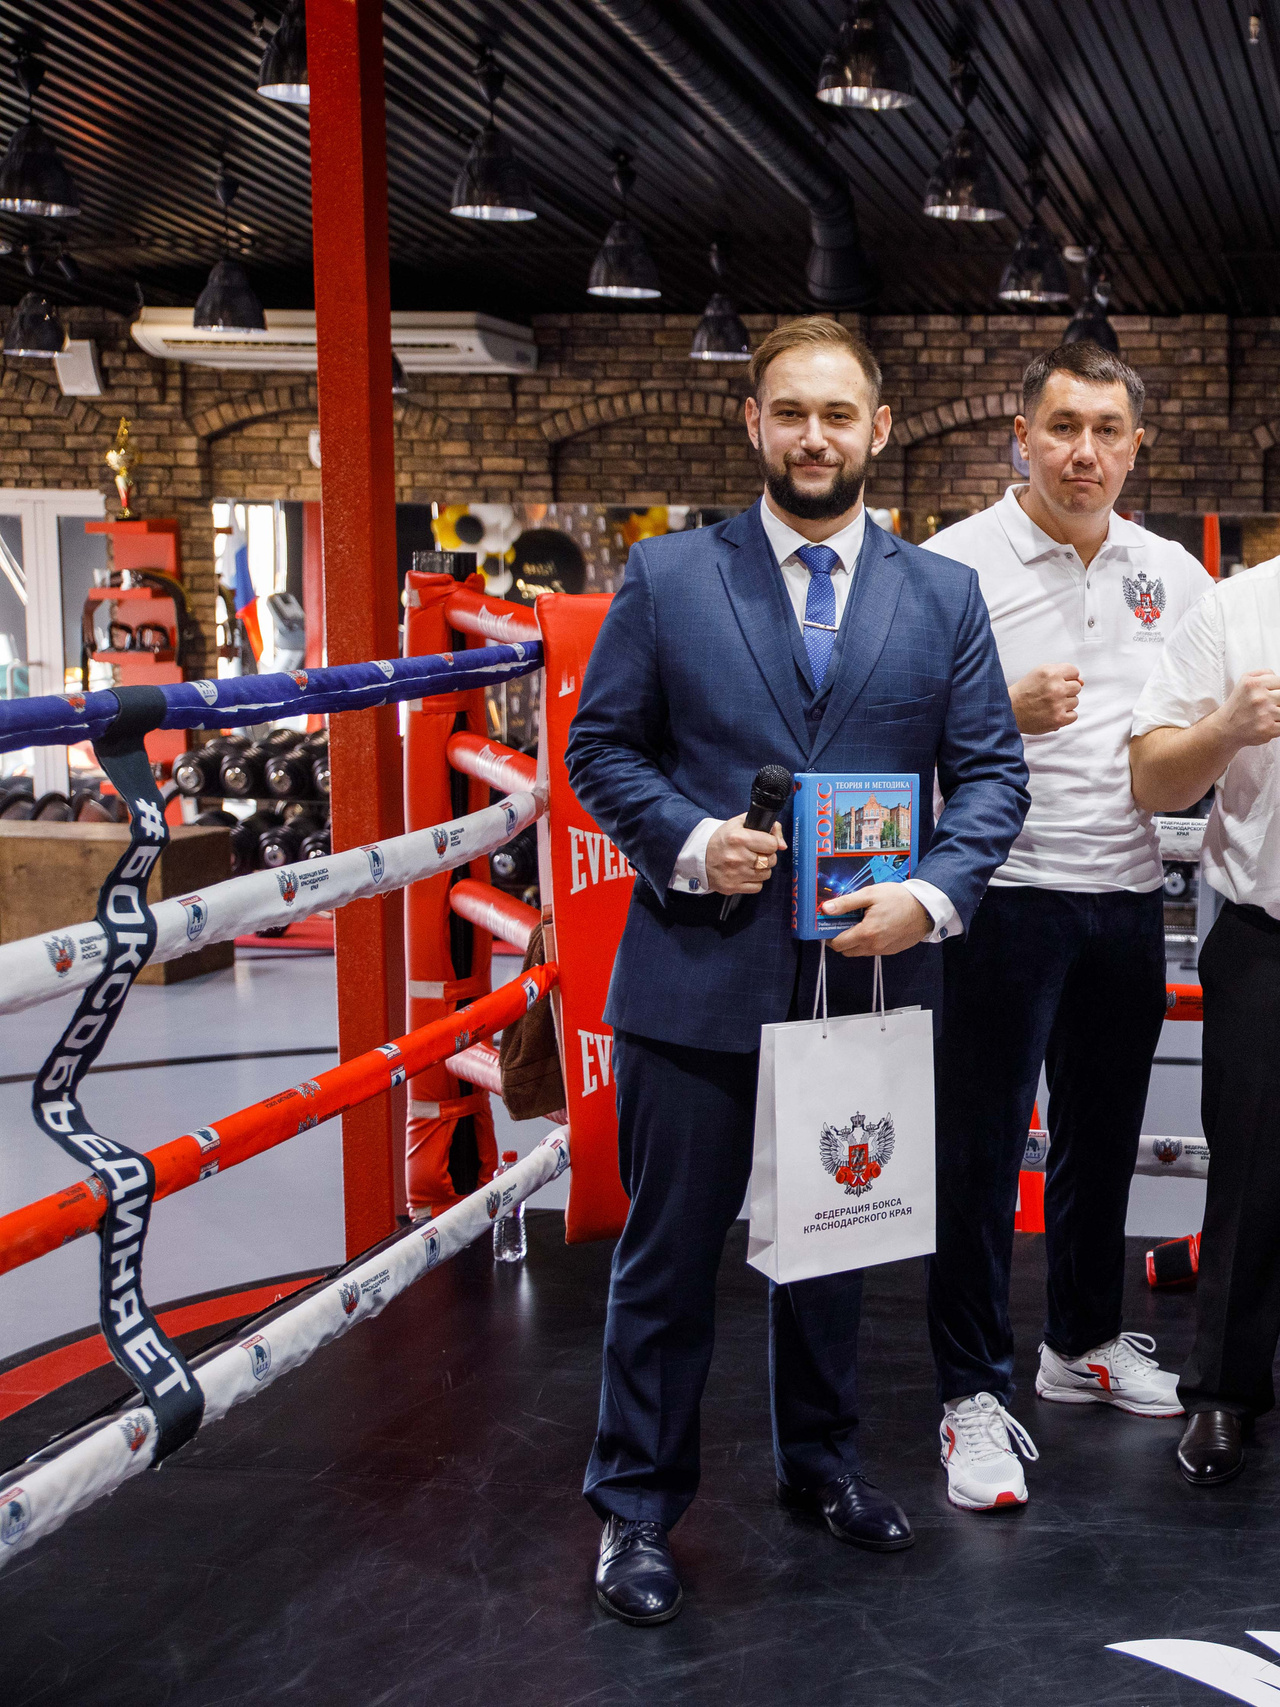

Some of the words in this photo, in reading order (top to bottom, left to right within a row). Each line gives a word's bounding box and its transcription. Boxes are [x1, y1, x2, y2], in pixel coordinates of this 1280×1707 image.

[836, 781, 863, 789] ТЕОРИЯ
[872, 781, 910, 789] МЕТОДИКА
[816, 782, 833, 855] БОКС
[40, 797, 192, 1397] #БОКСОБЪЕДИНЯЕТ
[803, 1213, 887, 1234] КРАСНОДАРСКОГО
[889, 1206, 912, 1219] КРАЯ
[814, 1203, 870, 1221] ФЕДЕРАЦИЯ
[872, 1197, 902, 1211] БОКСА
